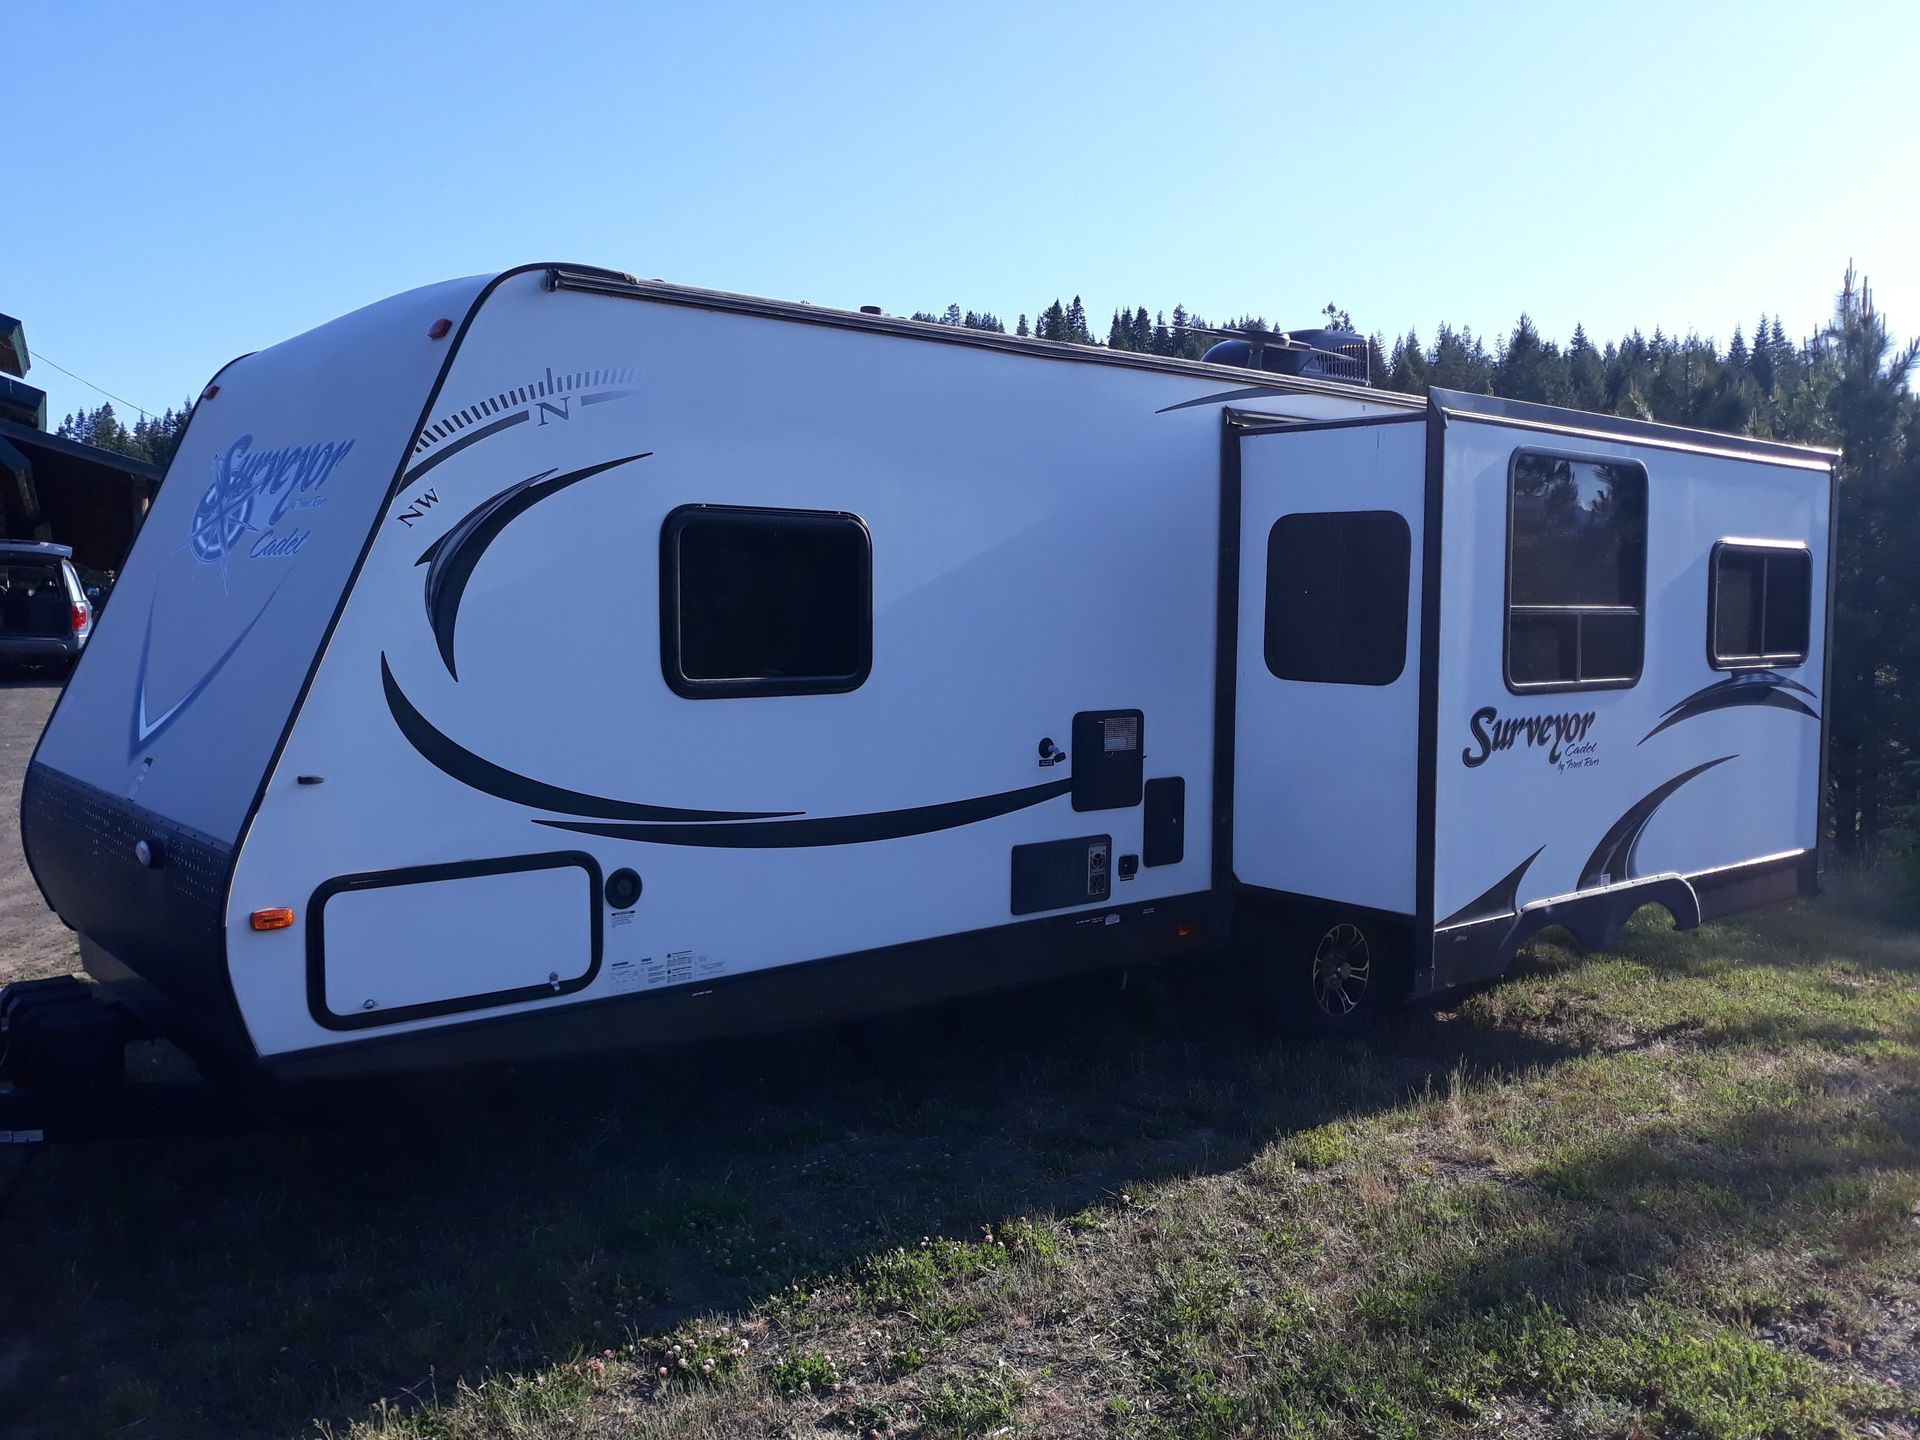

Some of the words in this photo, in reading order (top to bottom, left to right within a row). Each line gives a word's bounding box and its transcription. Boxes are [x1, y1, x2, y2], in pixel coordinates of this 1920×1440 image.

[535, 396, 572, 427] N
[211, 434, 355, 526] Surveyor
[396, 487, 440, 528] NW
[250, 528, 311, 559] Cadet
[1462, 706, 1596, 768] Surveyor
